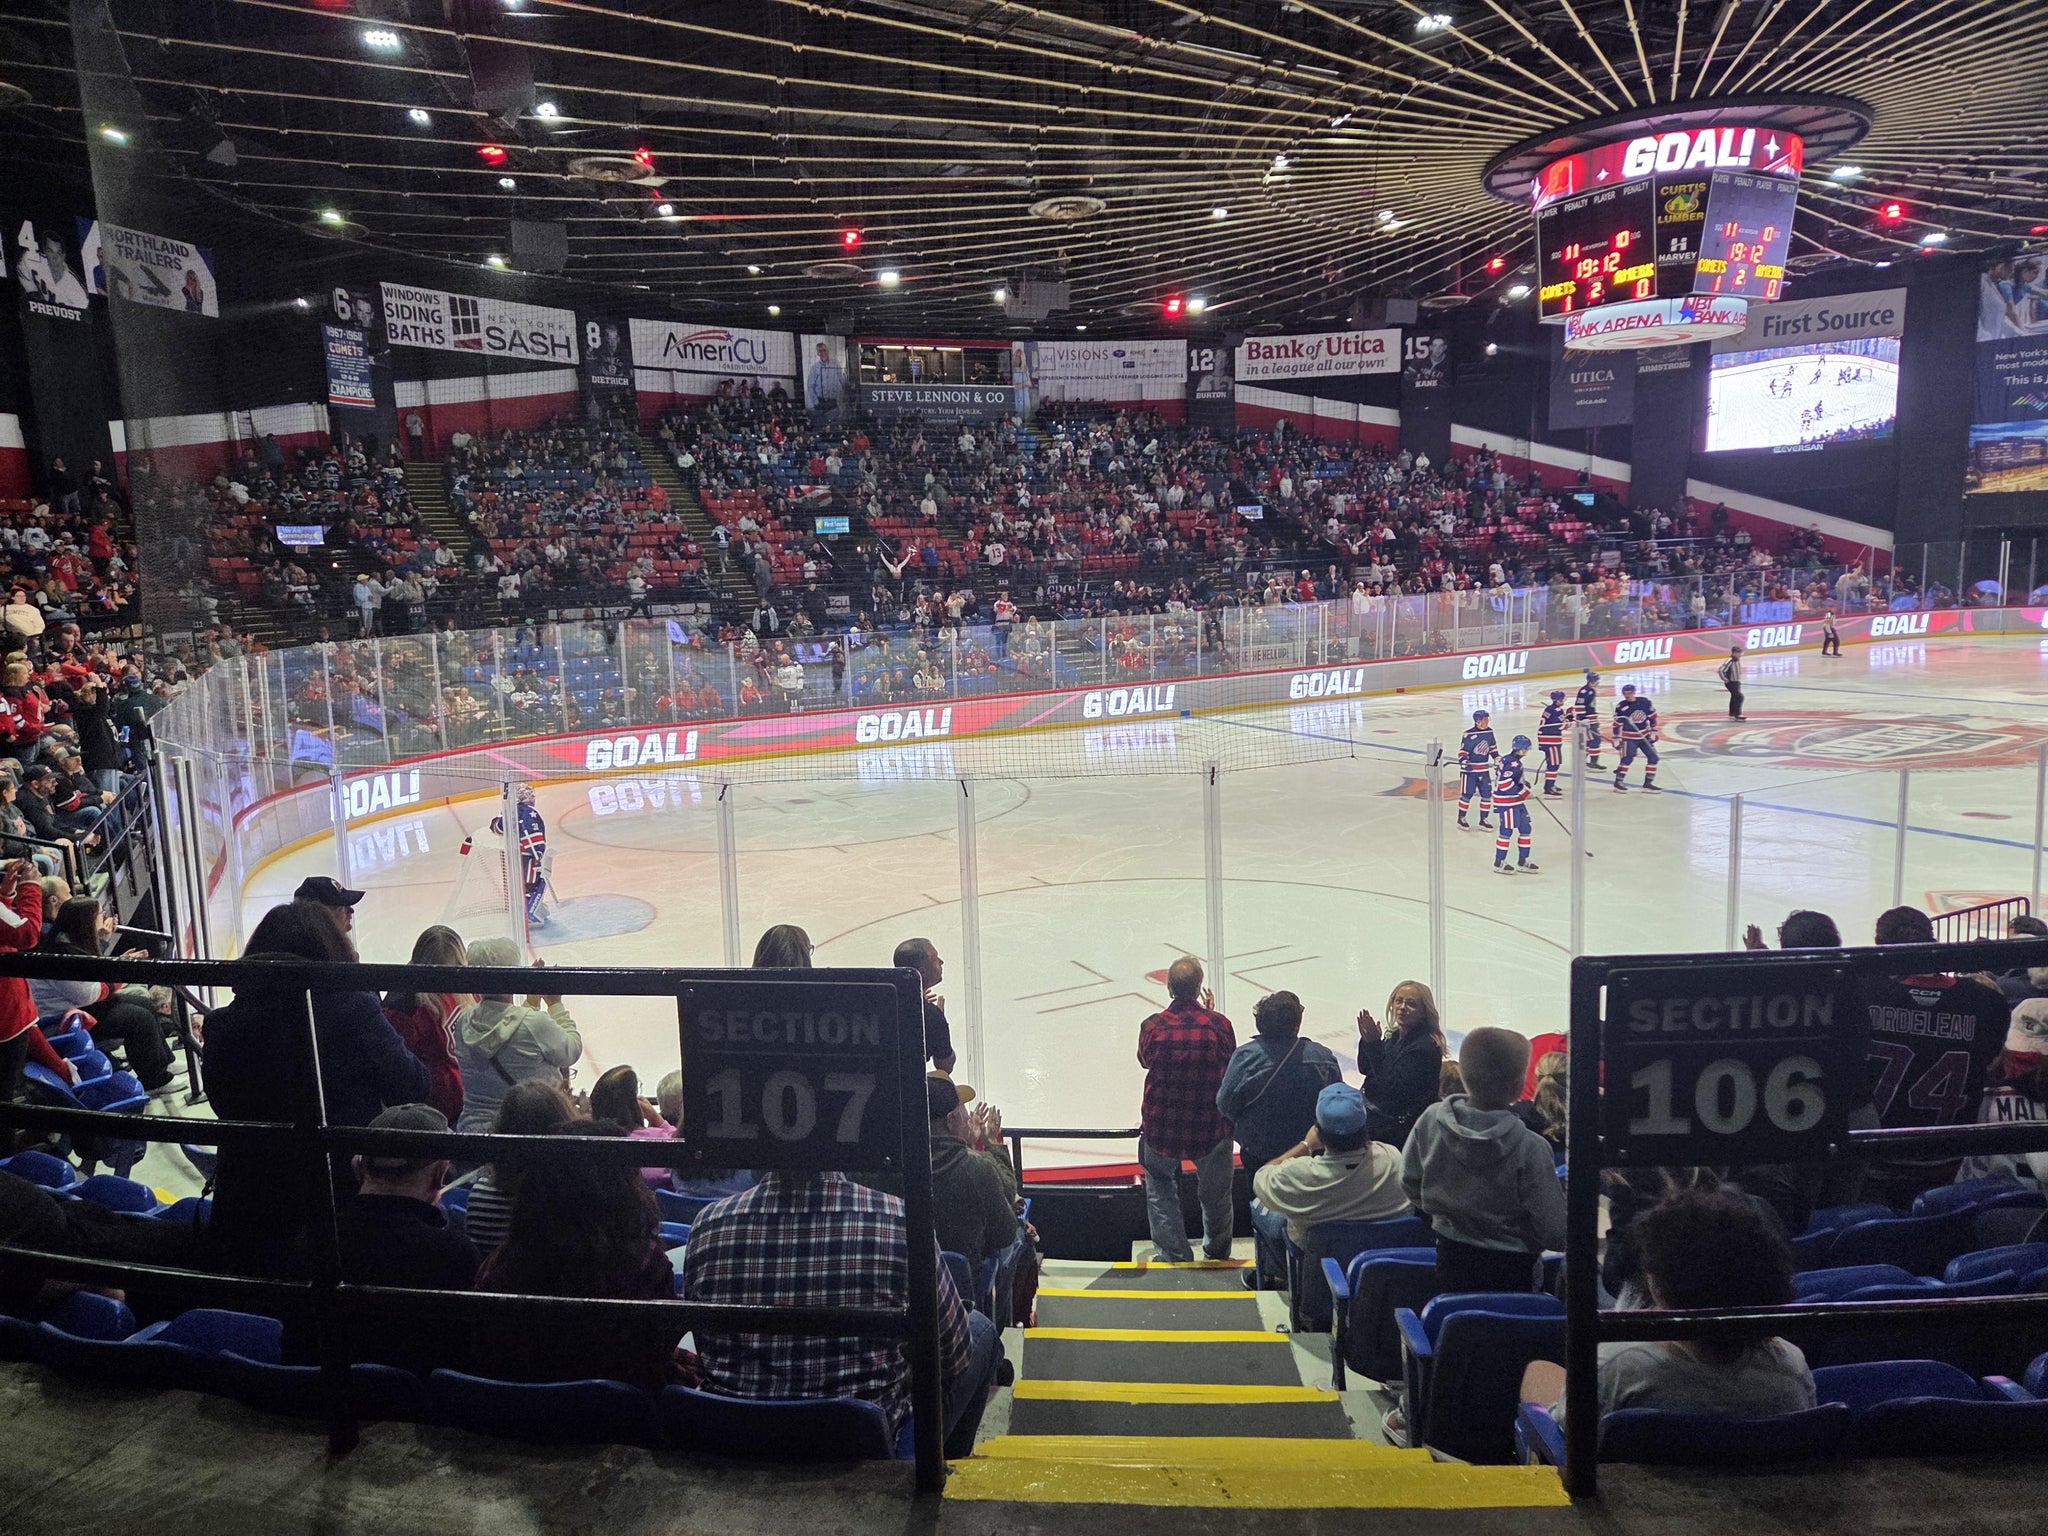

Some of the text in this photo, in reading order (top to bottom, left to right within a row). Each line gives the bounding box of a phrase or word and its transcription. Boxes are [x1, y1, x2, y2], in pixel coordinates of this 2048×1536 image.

[1621, 128, 1756, 178] GOAL!
[1660, 182, 1706, 195] CURTIS
[1713, 173, 1796, 193] PLAYER PENALTY PLAYER PENALTY
[1538, 181, 1649, 221] PLAYER PENALTY PLAYER PENALTY
[1657, 212, 1704, 224] LUMBER
[18, 220, 41, 258] 4
[115, 244, 182, 270] TRAILERS
[1565, 243, 1580, 261] 11
[1658, 251, 1697, 262] HARVEY
[1576, 252, 1621, 279] 19:12
[1714, 275, 1722, 292] 1
[1735, 269, 1746, 285] 2
[383, 286, 440, 305] WINDOWS
[1590, 281, 1602, 299] 2
[29, 300, 82, 322] PREVOST
[334, 287, 351, 320] 6
[385, 302, 442, 325] SIDING
[1564, 295, 1573, 312] 1
[1681, 296, 1717, 311] NBT
[488, 314, 566, 332] NEW YORK
[1602, 313, 1663, 334] ARENA
[1690, 310, 1732, 324] BANK
[1763, 308, 1896, 338] First Source
[388, 323, 446, 345] BATHS
[485, 325, 572, 358] SASH
[586, 320, 603, 350] 8
[328, 342, 363, 357] COMETS
[663, 331, 768, 364] AmeriCU
[1057, 350, 1109, 361] VISIONS
[1246, 334, 1385, 361] Bank of Utica
[1405, 336, 1430, 360] 15
[2019, 349, 2048, 358] York's
[722, 362, 744, 371] CREDIT
[1190, 349, 1214, 371] 12
[1246, 358, 1385, 376] in a league all our own
[1638, 361, 1691, 374] ARMSTRONG
[1995, 361, 2020, 370] most
[592, 375, 629, 386] DIETRICH
[1570, 369, 1615, 385] UTICA
[2003, 375, 2030, 386] This
[2033, 373, 2043, 384] is
[330, 383, 372, 398] CHAMPIONS
[871, 390, 1005, 403] STEVE LENNON & CO
[1196, 390, 1227, 399] BURTON
[1576, 398, 1607, 406] utica.edu
[1870, 613, 1930, 637] GOAL!
[1745, 624, 1803, 650] GOAL!
[1614, 637, 1674, 664] GOAL!
[1462, 650, 1529, 680] GOAL!
[1289, 669, 1364, 700] GOAL!
[856, 707, 952, 743] GOAL!
[585, 730, 699, 771] GOAL!
[1908, 988, 1942, 997] CCM
[1628, 993, 1835, 1033] SECTION
[699, 1010, 880, 1045] SECTION
[1865, 1040, 1970, 1125] 74
[706, 1069, 877, 1143] 107
[1629, 1056, 1827, 1136] 106
